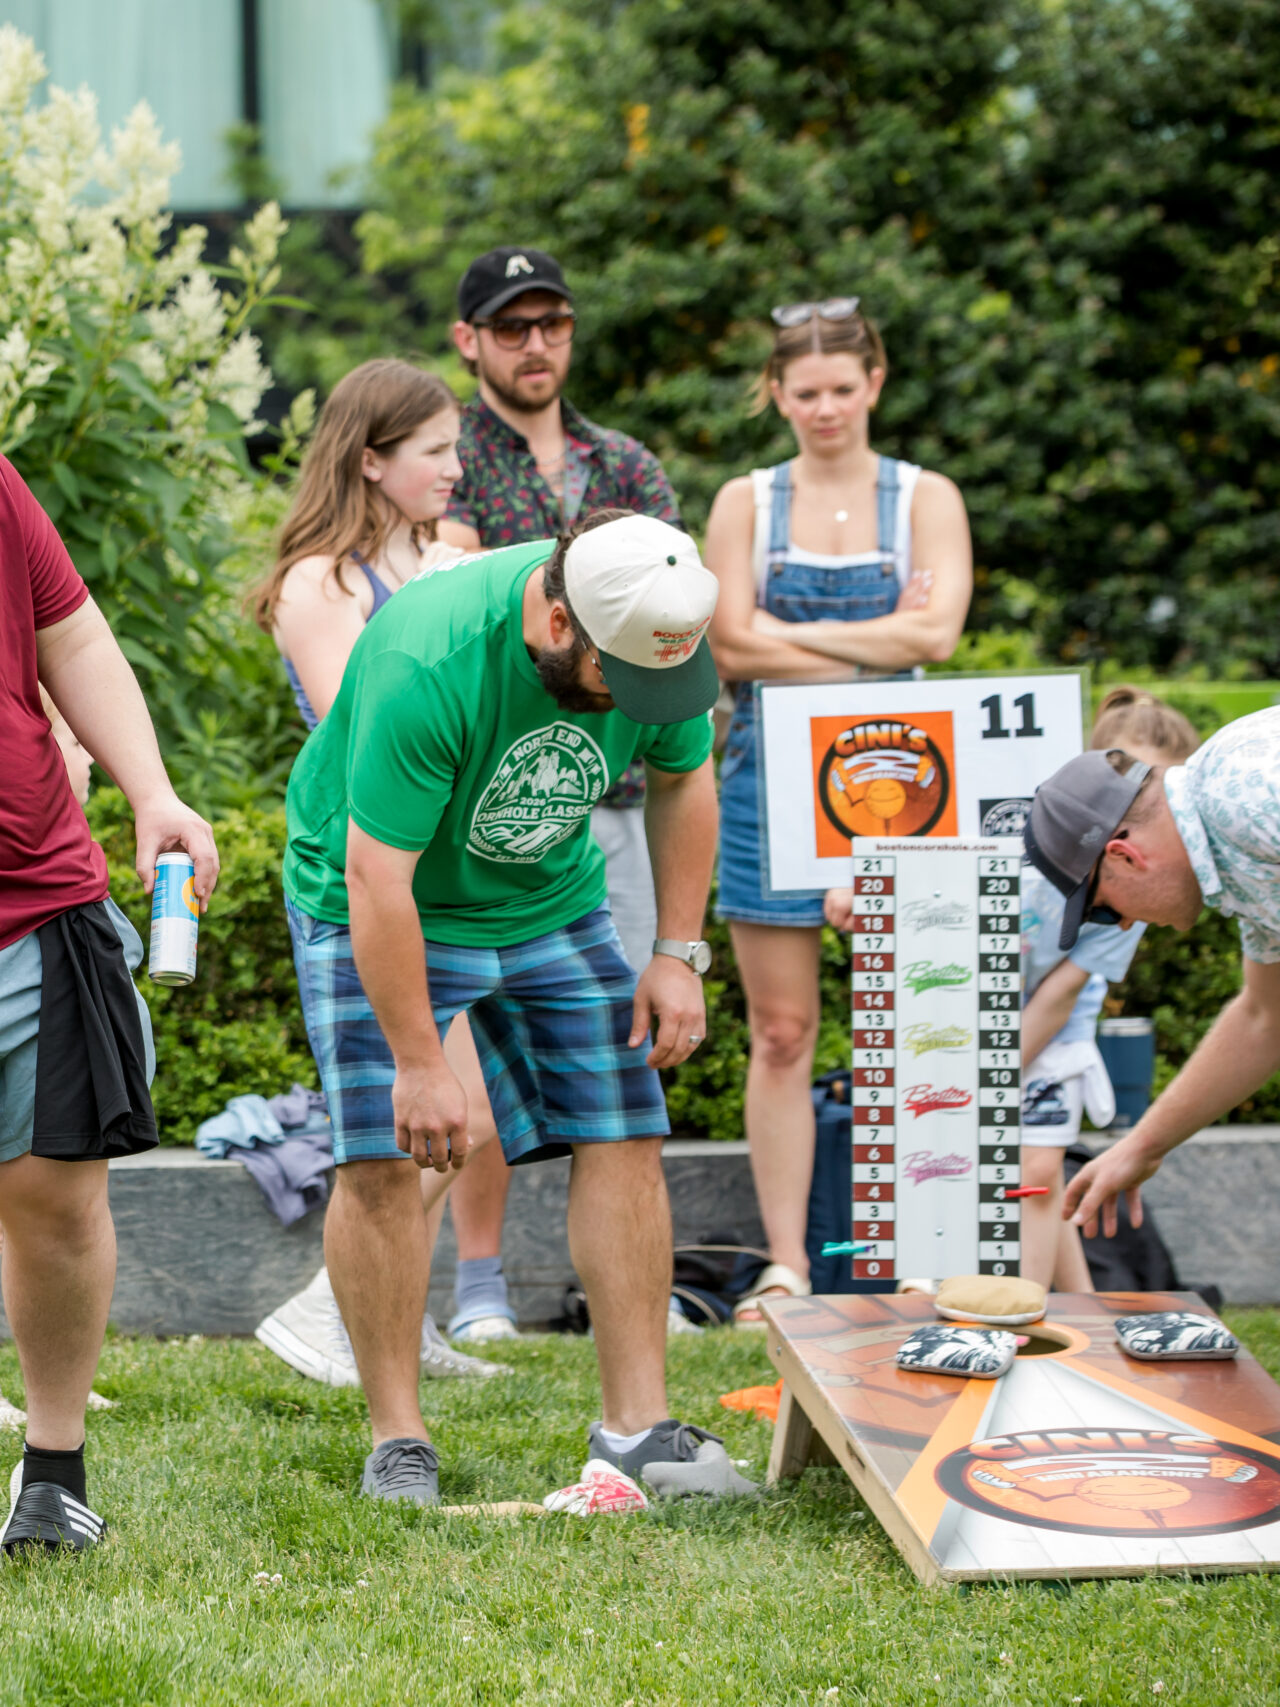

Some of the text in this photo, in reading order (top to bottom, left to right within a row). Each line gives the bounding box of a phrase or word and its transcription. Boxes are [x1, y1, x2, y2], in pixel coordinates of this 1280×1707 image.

[981, 692, 1044, 739] 11
[555, 728, 582, 748] END
[834, 723, 928, 756] CINI'S
[520, 797, 547, 806] 2026
[541, 804, 594, 818] CLASSIC
[863, 859, 880, 871] 21
[989, 859, 1006, 871] 21
[861, 878, 883, 892] 20
[986, 878, 1010, 893] 20
[864, 898, 883, 910] 19
[990, 899, 1009, 910] 19
[862, 916, 883, 930] 18
[987, 917, 1009, 931] 18
[864, 936, 883, 949] 17
[990, 937, 1009, 949] 17
[862, 955, 883, 968] 16
[987, 955, 1009, 969] 16
[865, 975, 883, 987] 15
[991, 975, 1009, 988] 15
[863, 993, 884, 1006] 14
[988, 994, 1010, 1008] 14
[865, 1013, 884, 1025] 13
[991, 1014, 1010, 1026] 13
[863, 1031, 885, 1045] 12
[989, 1032, 1011, 1046] 12
[865, 1052, 882, 1063] 11
[991, 1052, 1008, 1064] 11
[863, 1069, 885, 1083] 10
[989, 1070, 1011, 1084] 10
[869, 1090, 879, 1102] 9
[995, 1090, 1005, 1103] 9
[868, 1108, 880, 1122] 8
[993, 1108, 1006, 1122] 8
[869, 1128, 879, 1140] 7
[995, 1129, 1005, 1141] 7
[867, 1147, 880, 1160] 6
[993, 1147, 1006, 1161] 6
[870, 1166, 878, 1179] 5
[996, 1167, 1004, 1180] 5
[868, 1185, 880, 1198] 4
[993, 1186, 1005, 1199] 4
[870, 1205, 878, 1217] 3
[995, 1206, 1004, 1218] 3
[867, 1223, 879, 1236] 2
[992, 1223, 1005, 1237] 2
[995, 1244, 1003, 1256] 1
[867, 1261, 880, 1275] 0
[992, 1262, 1005, 1276] 0
[970, 1431, 1221, 1459] CINI'S
[1087, 1469, 1206, 1479] ARANCINIS
